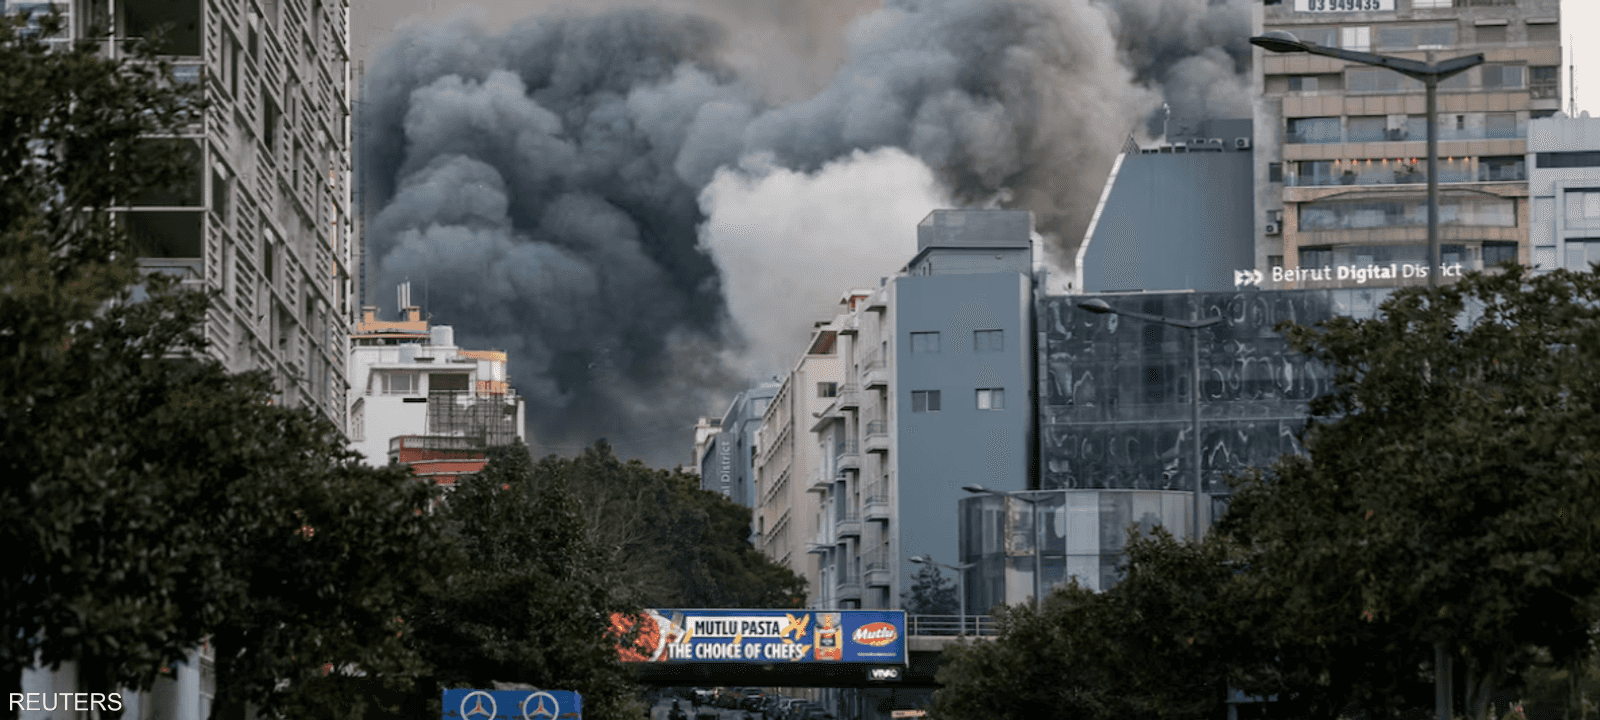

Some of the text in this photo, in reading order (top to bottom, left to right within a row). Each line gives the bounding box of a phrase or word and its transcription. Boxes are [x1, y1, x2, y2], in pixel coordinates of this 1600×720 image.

[1308, 0, 1380, 11] 03 949435
[1272, 262, 1463, 284] Beirut Digital Disict
[720, 441, 731, 483] District
[695, 621, 780, 635] MUTLU PASTA
[852, 627, 896, 641] Mutlu
[669, 643, 803, 659] THE CHOICE OF CHEFS
